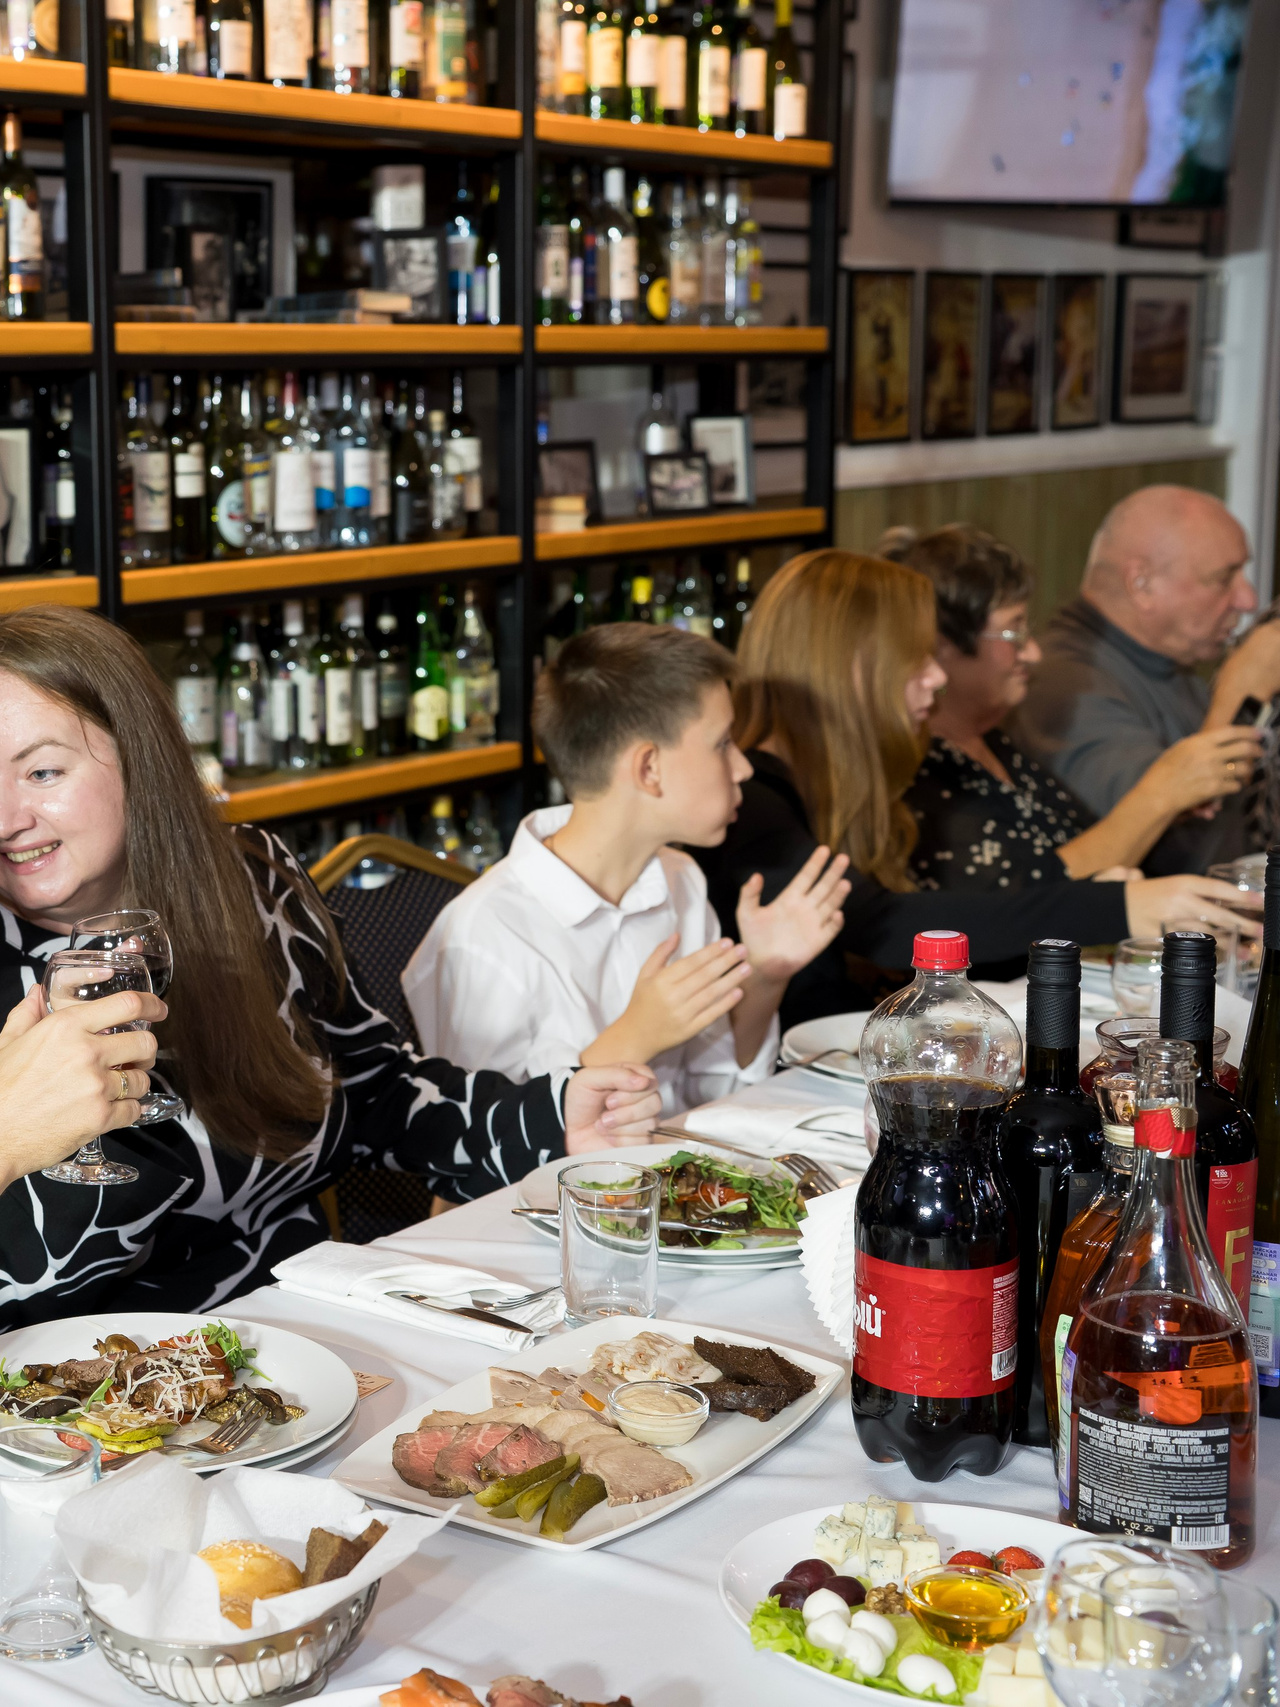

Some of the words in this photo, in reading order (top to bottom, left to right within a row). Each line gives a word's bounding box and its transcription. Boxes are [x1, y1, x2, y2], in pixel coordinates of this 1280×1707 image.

[1116, 1435, 1148, 1452] ВИНОГРАДА
[1153, 1443, 1176, 1454] РОССИЯ.
[1177, 1444, 1189, 1457] ГОД
[1190, 1444, 1212, 1455] УРОЖАЯ
[1216, 1443, 1229, 1454] 2023
[1130, 1523, 1140, 1531] 02
[1124, 1528, 1135, 1536] 30
